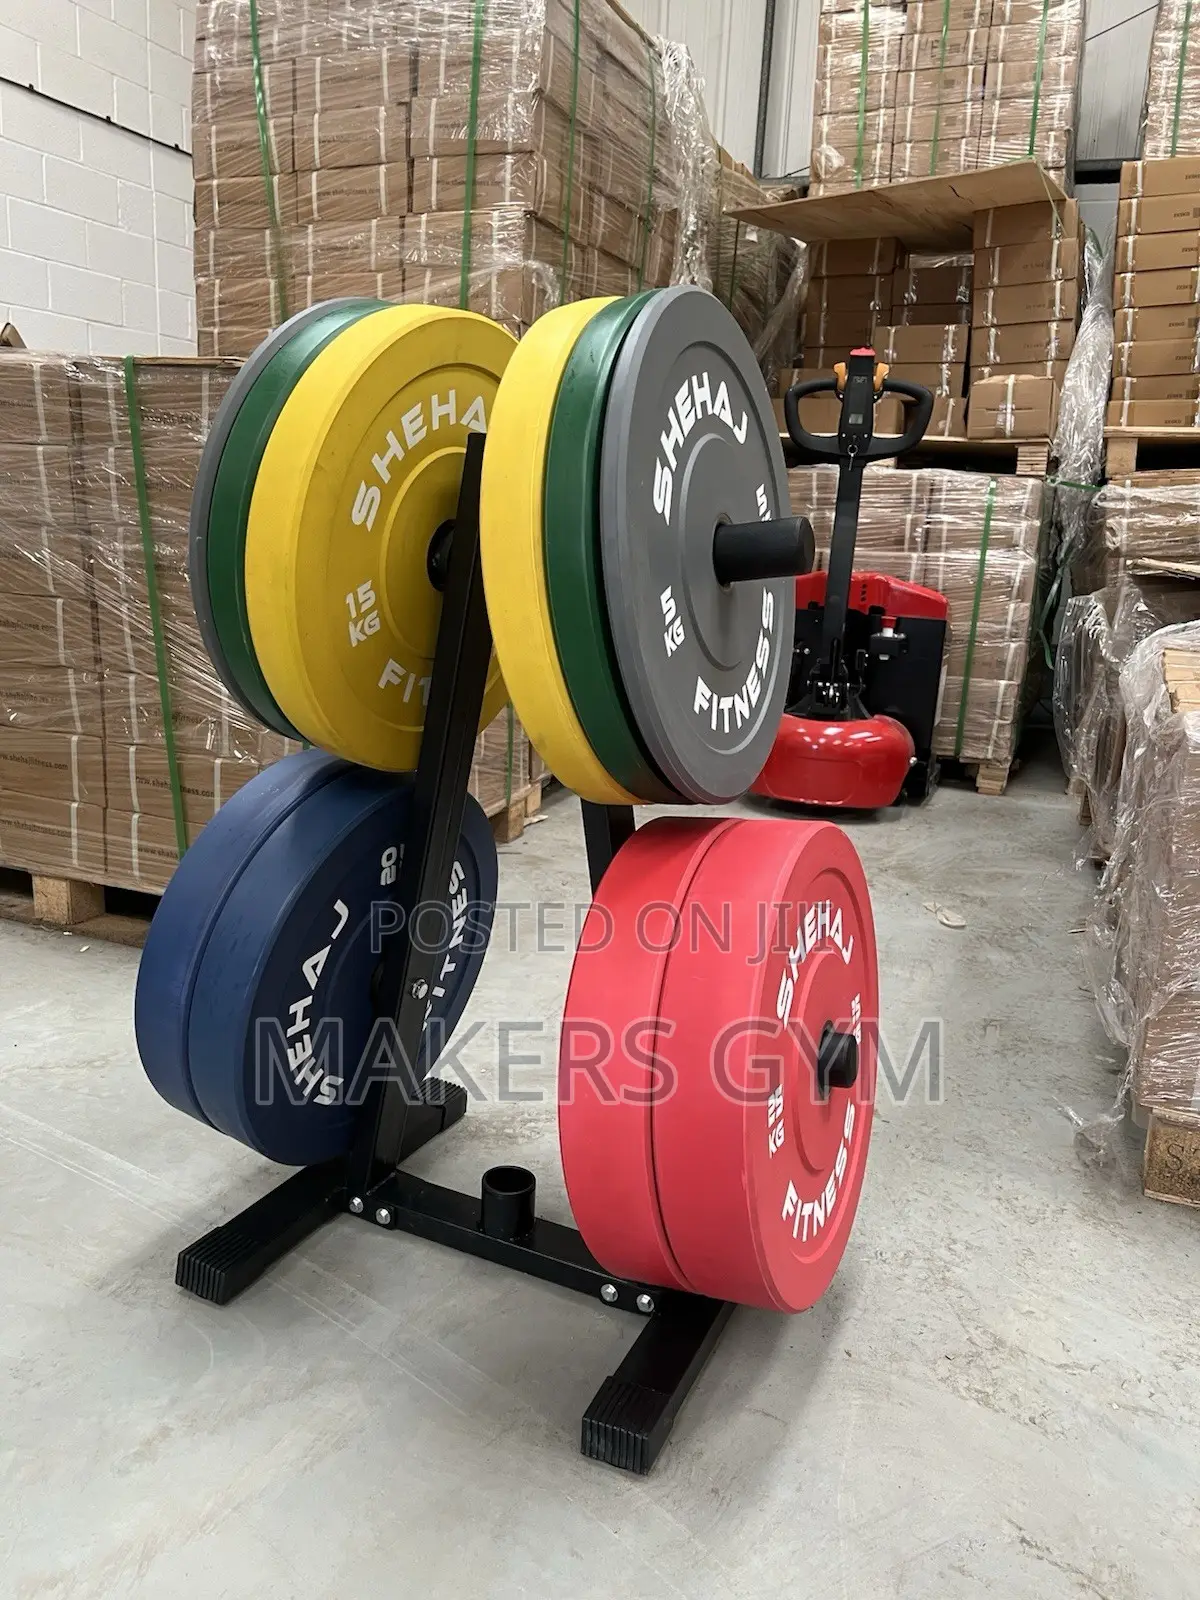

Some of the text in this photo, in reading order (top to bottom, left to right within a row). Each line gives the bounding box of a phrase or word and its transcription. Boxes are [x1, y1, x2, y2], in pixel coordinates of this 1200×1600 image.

[351, 389, 487, 532] SHEHA
[653, 372, 749, 526] SHEHAJ
[345, 580, 376, 617] 15
[660, 585, 677, 623] 5
[349, 610, 381, 647] KG
[663, 619, 686, 658] KG
[693, 586, 774, 734] FITNESS
[380, 846, 397, 886] 20
[776, 899, 855, 1030] SHEHAJ
[287, 899, 349, 1106] SHEHAJ
[768, 1083, 784, 1129] 25
[768, 1120, 786, 1160] KG
[781, 1098, 856, 1243] FITNESS
